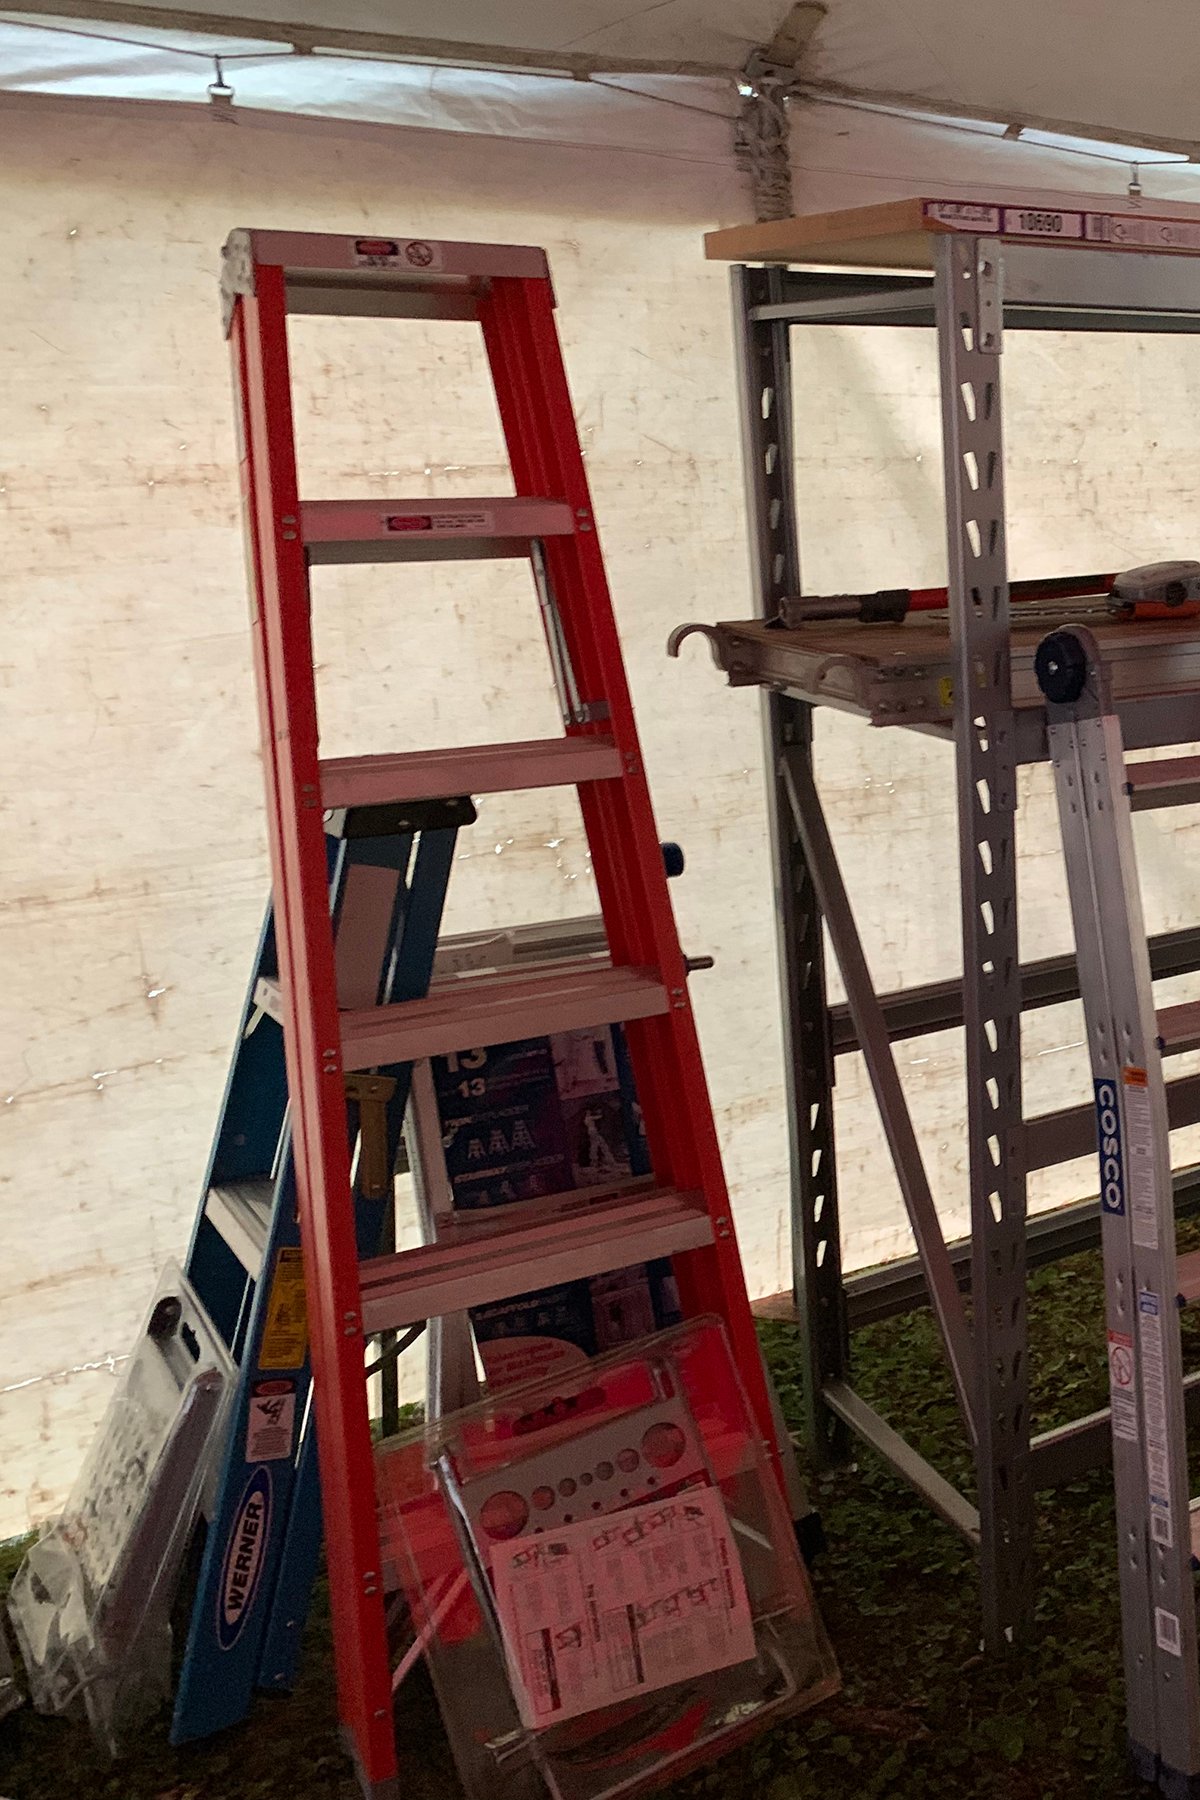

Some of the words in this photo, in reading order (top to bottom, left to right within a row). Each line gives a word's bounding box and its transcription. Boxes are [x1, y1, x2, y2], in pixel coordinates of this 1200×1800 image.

[457, 1076, 487, 1099] 13
[1098, 1084, 1122, 1209] COSCO
[227, 1501, 264, 1611] WERNER
